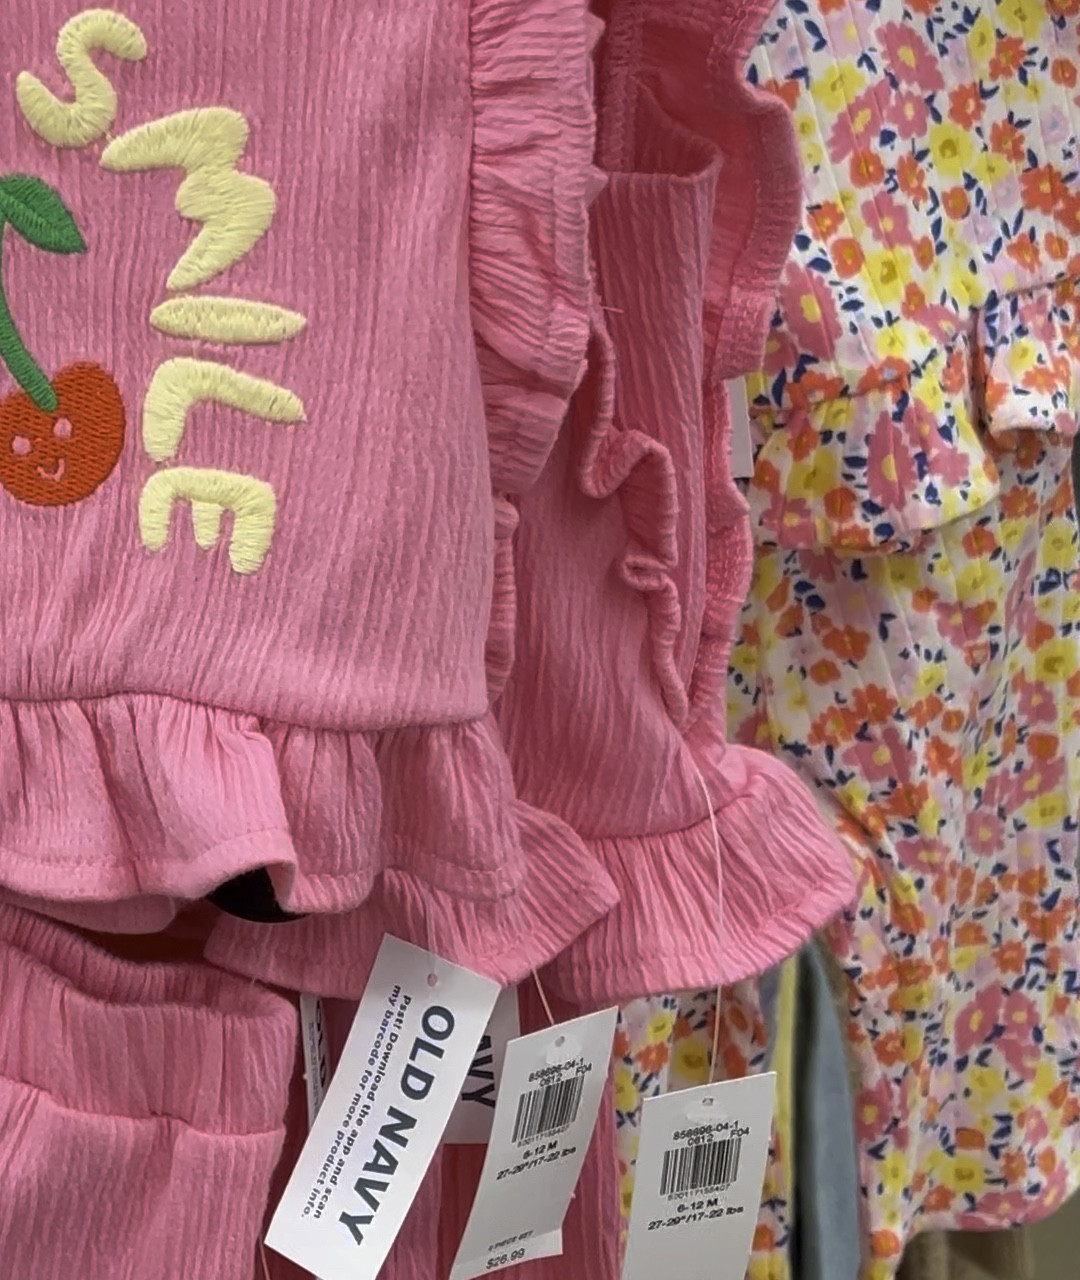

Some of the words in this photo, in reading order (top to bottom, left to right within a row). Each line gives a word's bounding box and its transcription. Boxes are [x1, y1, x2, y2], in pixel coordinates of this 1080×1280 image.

[16, 7, 308, 575] SMILE
[388, 985, 402, 1007] my
[393, 995, 412, 1030] Psst!
[367, 1009, 395, 1067] barcode
[400, 1005, 456, 1101] OLD
[359, 1069, 373, 1091] for
[367, 1032, 399, 1102] Download
[342, 1092, 361, 1128] more
[356, 1104, 371, 1127] the
[343, 1129, 358, 1156] app
[546, 1140, 558, 1150] M
[730, 1126, 750, 1138] F04
[316, 1130, 345, 1185] product
[330, 1158, 345, 1185] and
[338, 1105, 419, 1247] NAVY
[301, 1187, 321, 1218] info.
[313, 1187, 332, 1219] scan
[677, 1200, 704, 1213] 6-12
[706, 1198, 718, 1208] M
